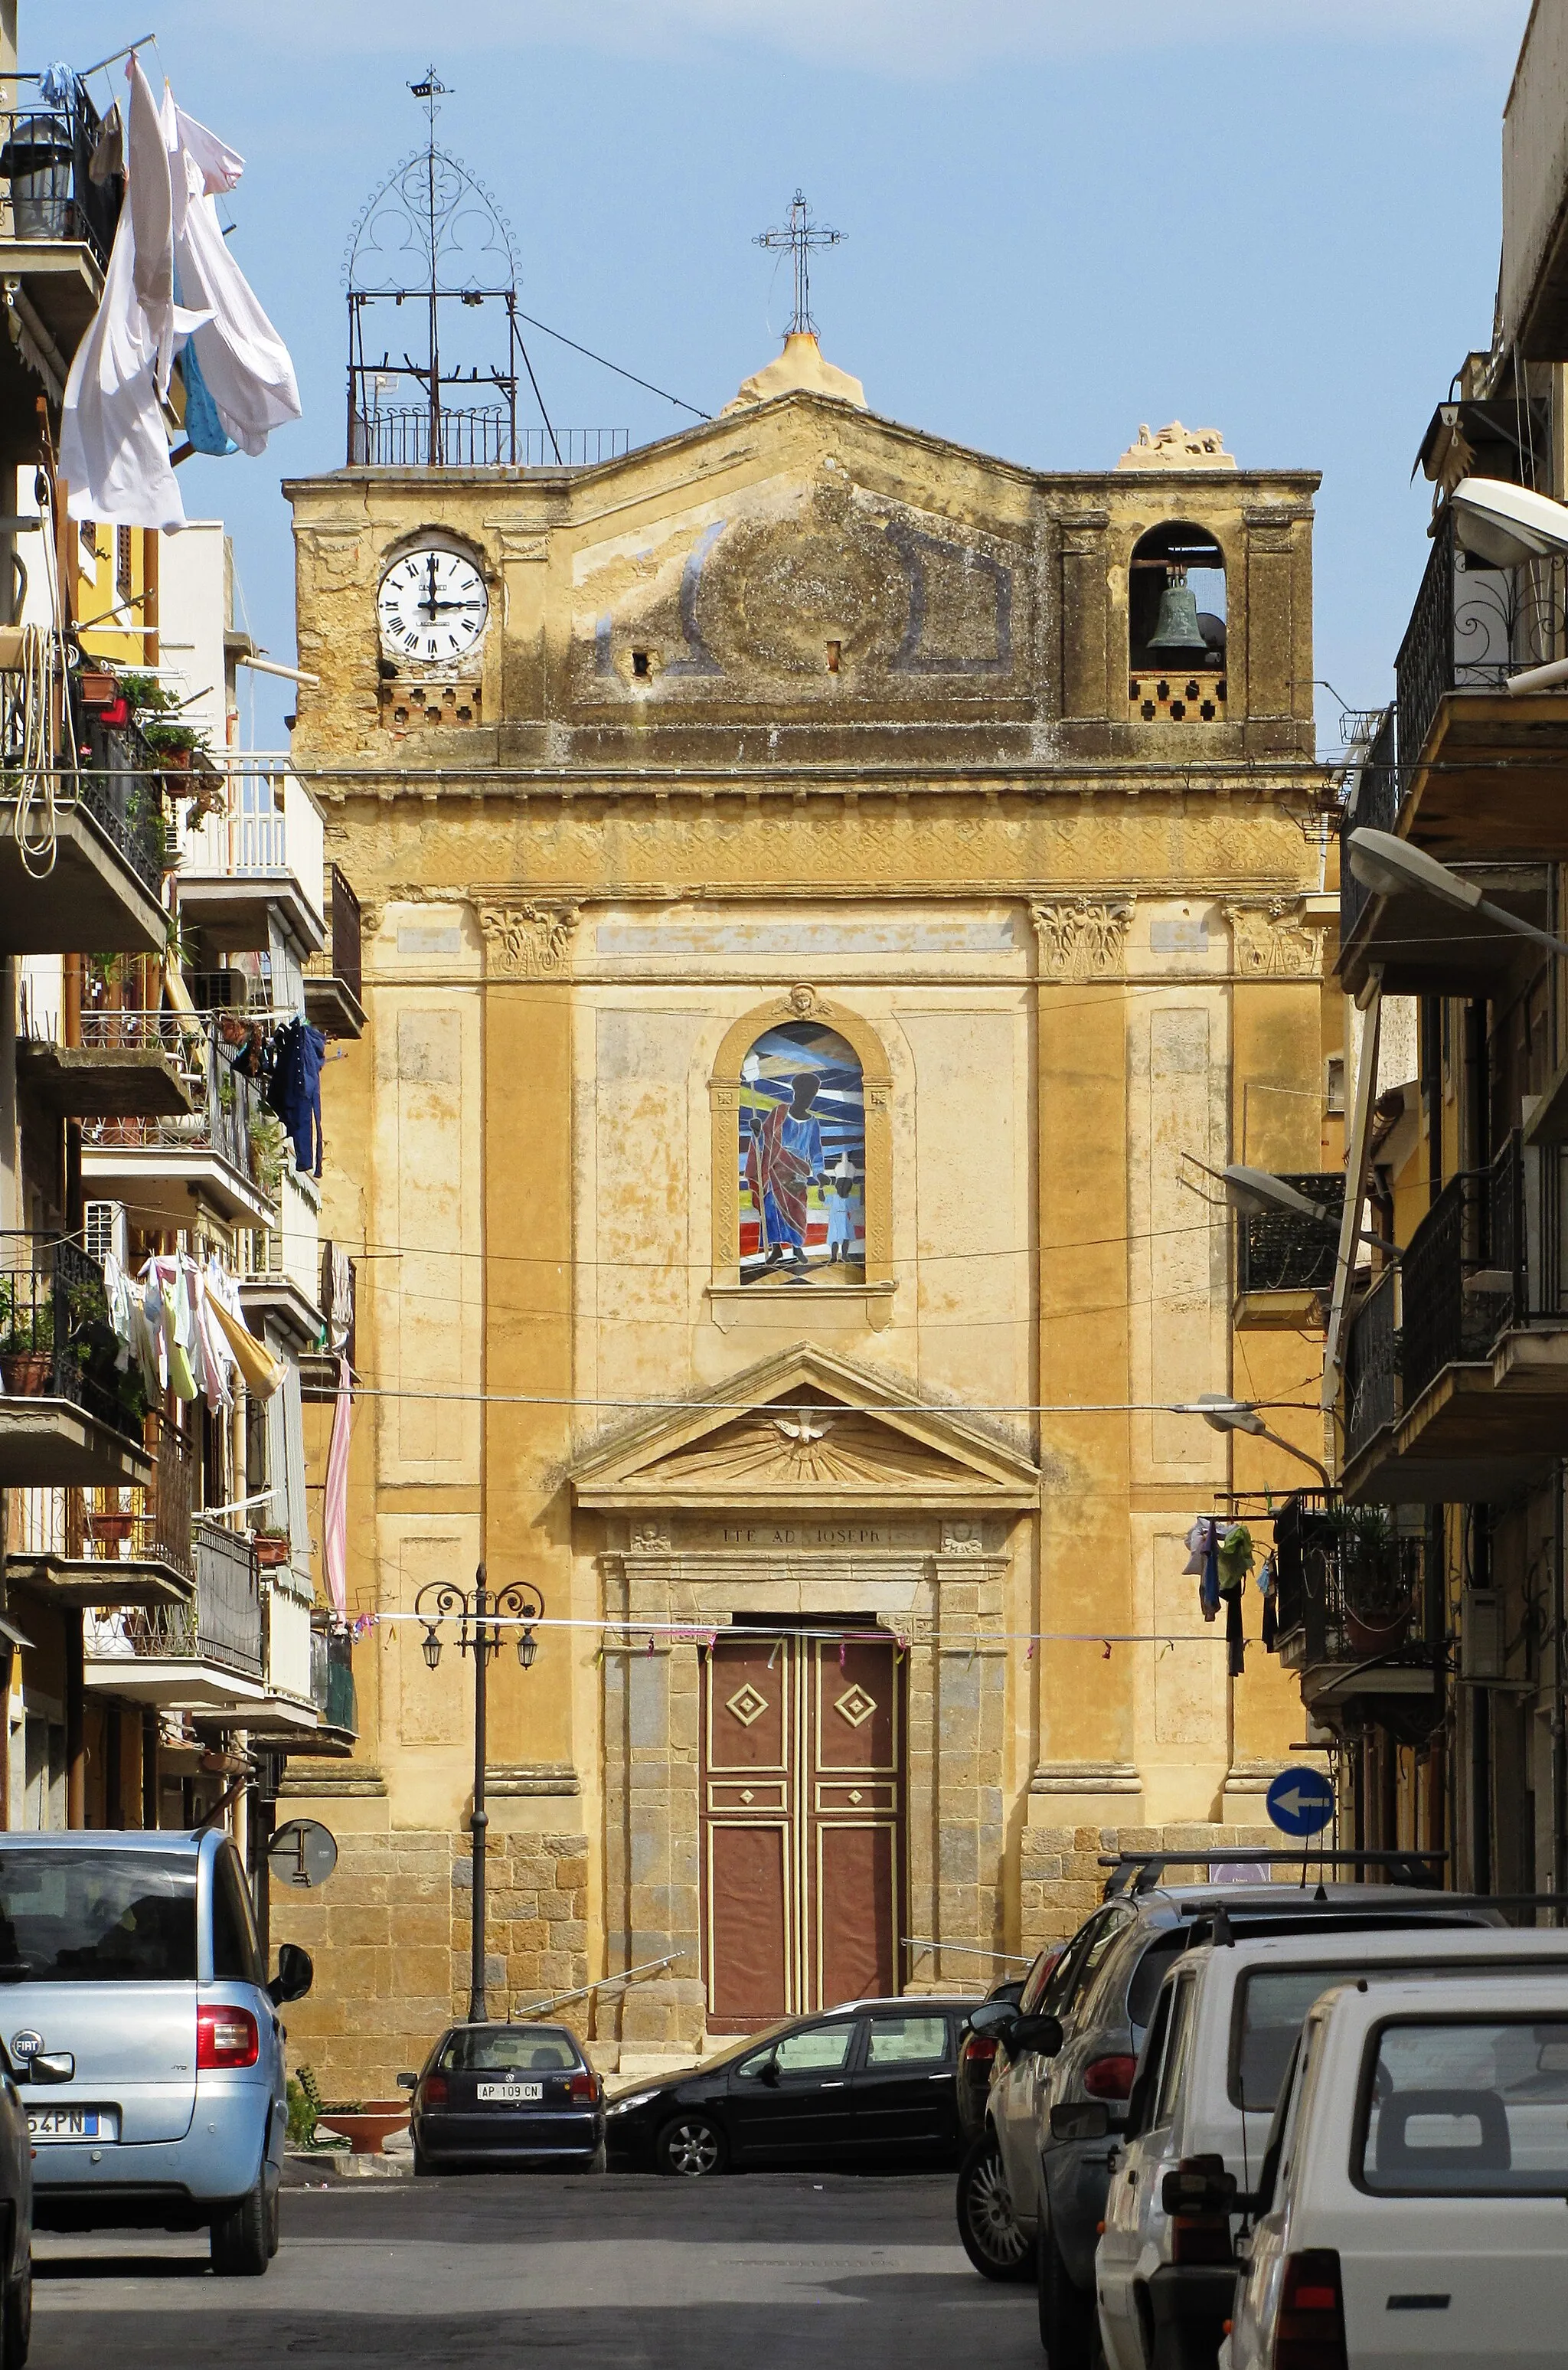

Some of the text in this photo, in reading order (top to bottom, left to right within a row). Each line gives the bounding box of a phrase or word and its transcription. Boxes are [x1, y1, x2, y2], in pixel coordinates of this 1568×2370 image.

[405, 563, 420, 578] XI
[390, 580, 404, 591] X
[461, 580, 475, 590] II
[385, 601, 399, 611] IX
[466, 600, 481, 610] III
[388, 616, 406, 636] VIII
[404, 633, 419, 649] VII
[428, 639, 437, 653] VI
[449, 635, 459, 648] V
[723, 1529, 756, 1542] ITE
[772, 1530, 795, 1543] AD
[15, 2040, 38, 2051] FIAT
[482, 2086, 537, 2097] AP 109 CN
